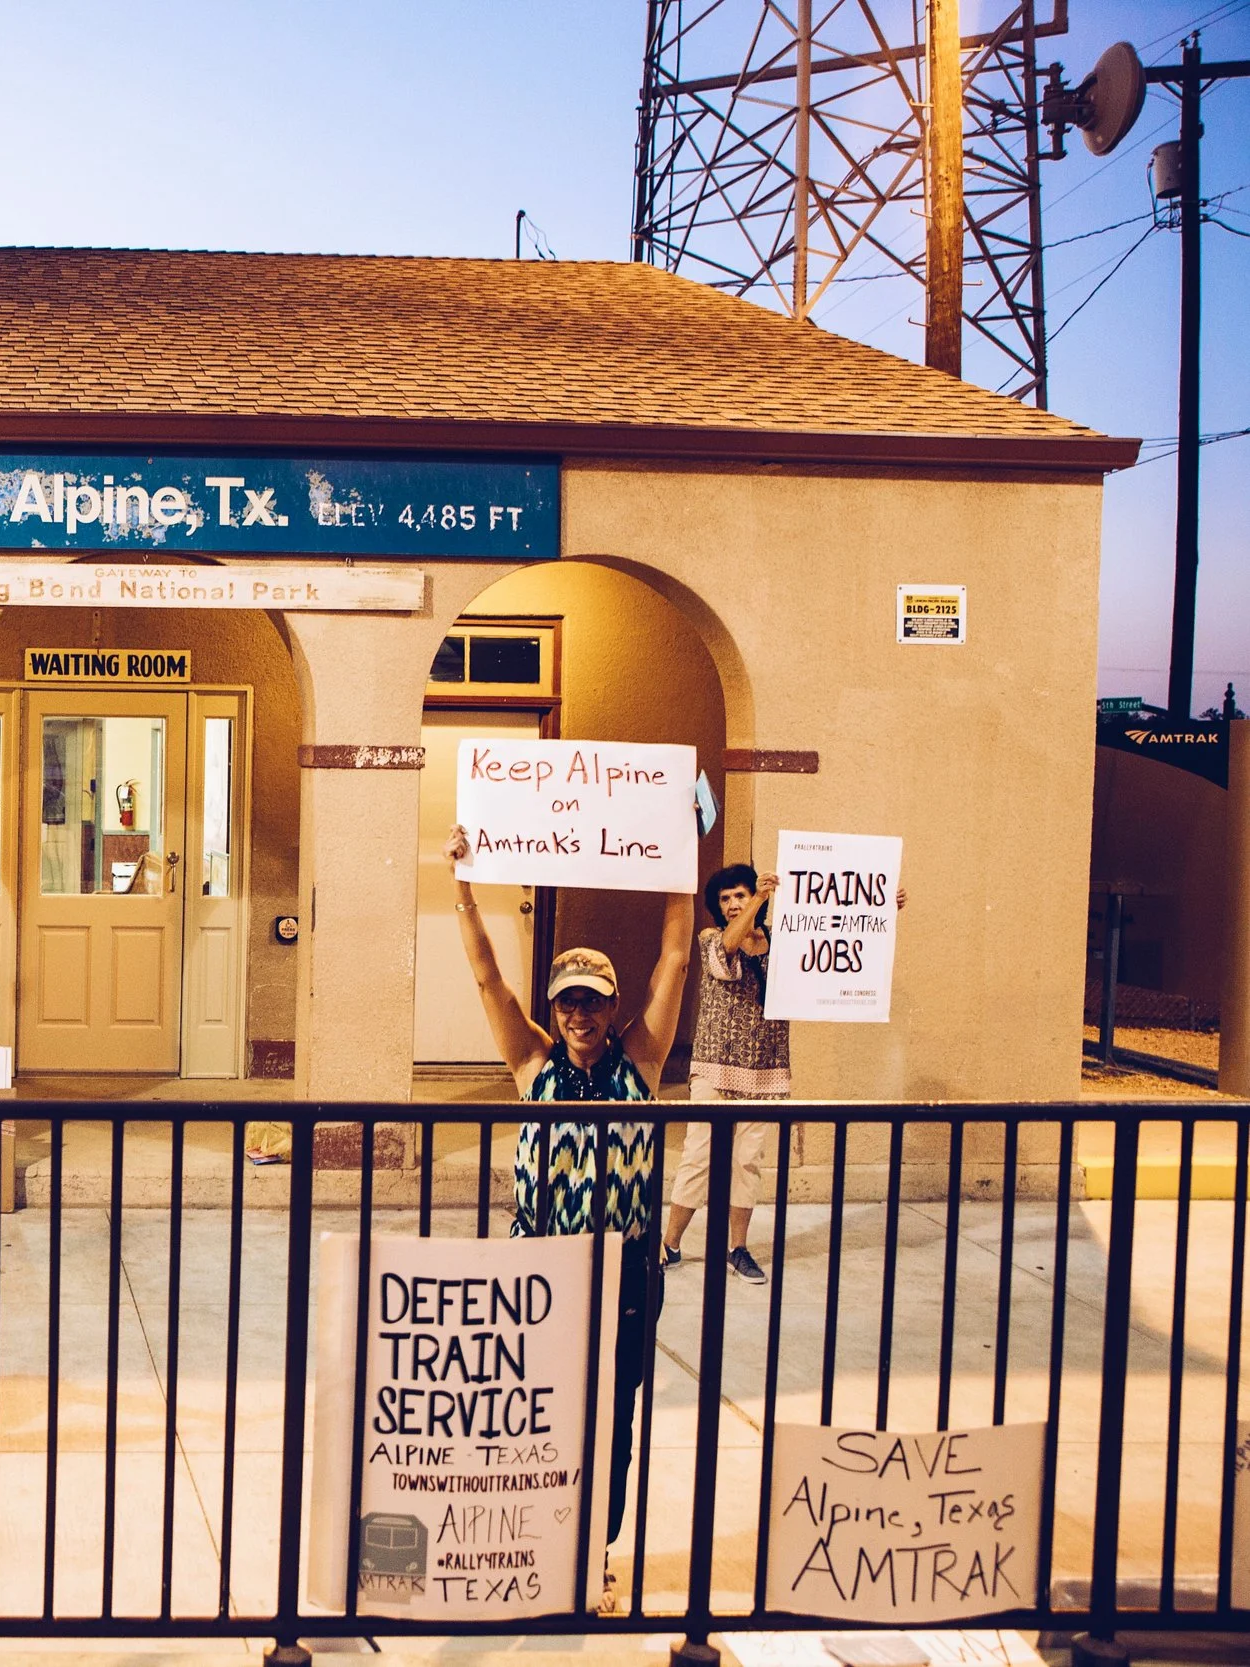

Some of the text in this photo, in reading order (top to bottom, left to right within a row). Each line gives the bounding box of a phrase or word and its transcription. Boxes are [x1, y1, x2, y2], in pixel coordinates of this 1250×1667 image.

[9, 474, 289, 536] Alpine, Tx.
[398, 504, 476, 531] 4,485
[489, 507, 523, 531] FT
[95, 567, 197, 579] GATEWAY TO
[29, 578, 101, 598] Bend
[120, 580, 234, 600] National
[253, 582, 320, 600] Park
[906, 605, 957, 614] BLDG-2125
[31, 653, 185, 677] WAITING ROOM
[1119, 701, 1141, 709] Street
[1149, 734, 1218, 743] AMTRAK
[470, 748, 667, 797] Keep Alpine
[551, 797, 580, 813] on
[475, 827, 662, 859] Amtrak's Line
[789, 870, 886, 906] TRAINS
[780, 913, 827, 932] ALPINE
[801, 939, 863, 972] JOBS
[381, 1273, 551, 1325] DEFEND
[379, 1332, 525, 1383] TRAIN
[373, 1386, 553, 1438] SERVICE
[369, 1442, 454, 1466] ALPINE
[476, 1443, 558, 1466] TEXAS
[822, 1432, 982, 1480] SAVE
[392, 1471, 568, 1492] TOWNSWITHOUTTRAINS.COM
[783, 1476, 1015, 1547] Alpine, Texas
[437, 1550, 535, 1570] #RALLY4TRAINS
[791, 1538, 1019, 1607] AMTRAK
[433, 1572, 541, 1602] TEXAS
